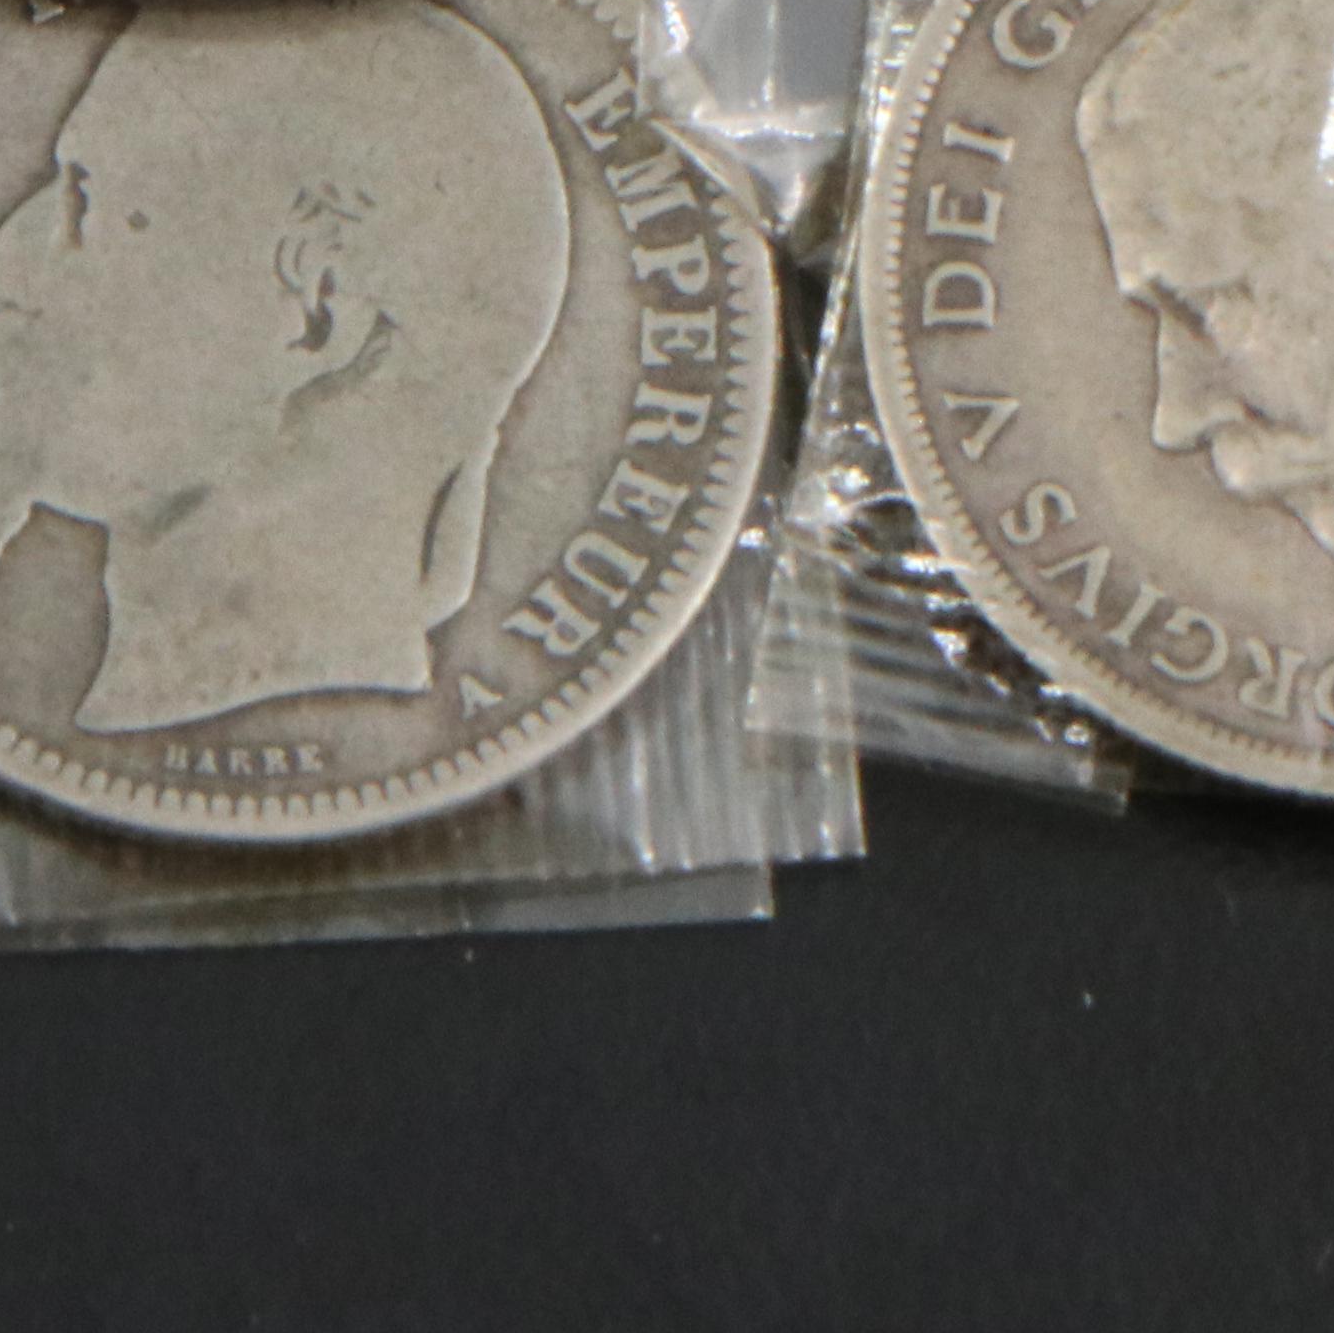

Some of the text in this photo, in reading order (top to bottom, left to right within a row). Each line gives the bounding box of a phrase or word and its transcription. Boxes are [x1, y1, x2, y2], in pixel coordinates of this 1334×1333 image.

[922, 121, 1015, 329] DEI
[503, 68, 719, 657] EMPEREUR
[941, 390, 1021, 461] V
